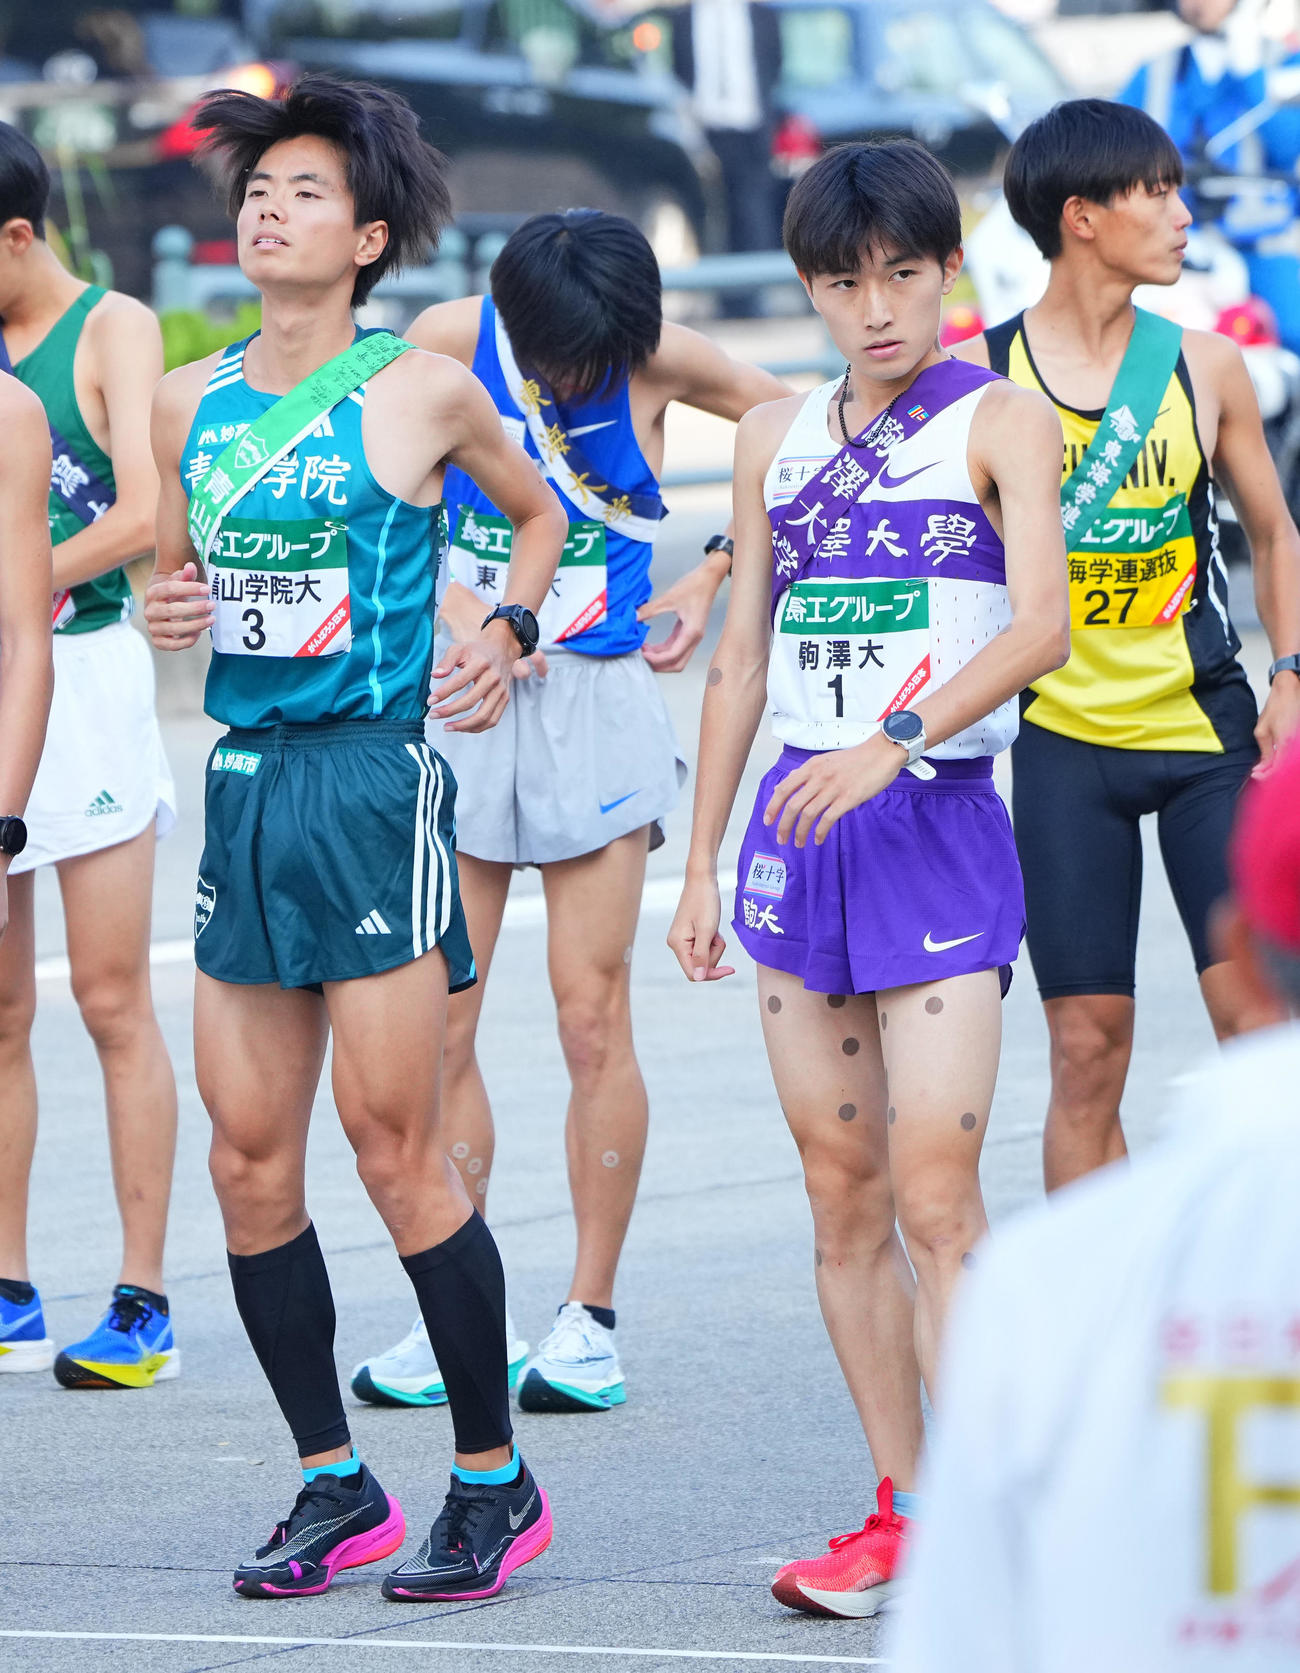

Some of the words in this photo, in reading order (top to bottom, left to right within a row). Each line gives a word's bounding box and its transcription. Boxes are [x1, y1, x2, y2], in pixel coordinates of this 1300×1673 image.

[186, 451, 351, 505] 青学院
[1084, 587, 1139, 626] 27
[241, 608, 267, 651] 3
[307, 607, 347, 654] がんばろう日本
[798, 639, 885, 671] 駒澤大
[827, 674, 844, 718] 1
[223, 751, 259, 773] 妙高市
[84, 804, 123, 817] adidas
[752, 862, 785, 884] 桜十字
[743, 898, 785, 935] 駒大
